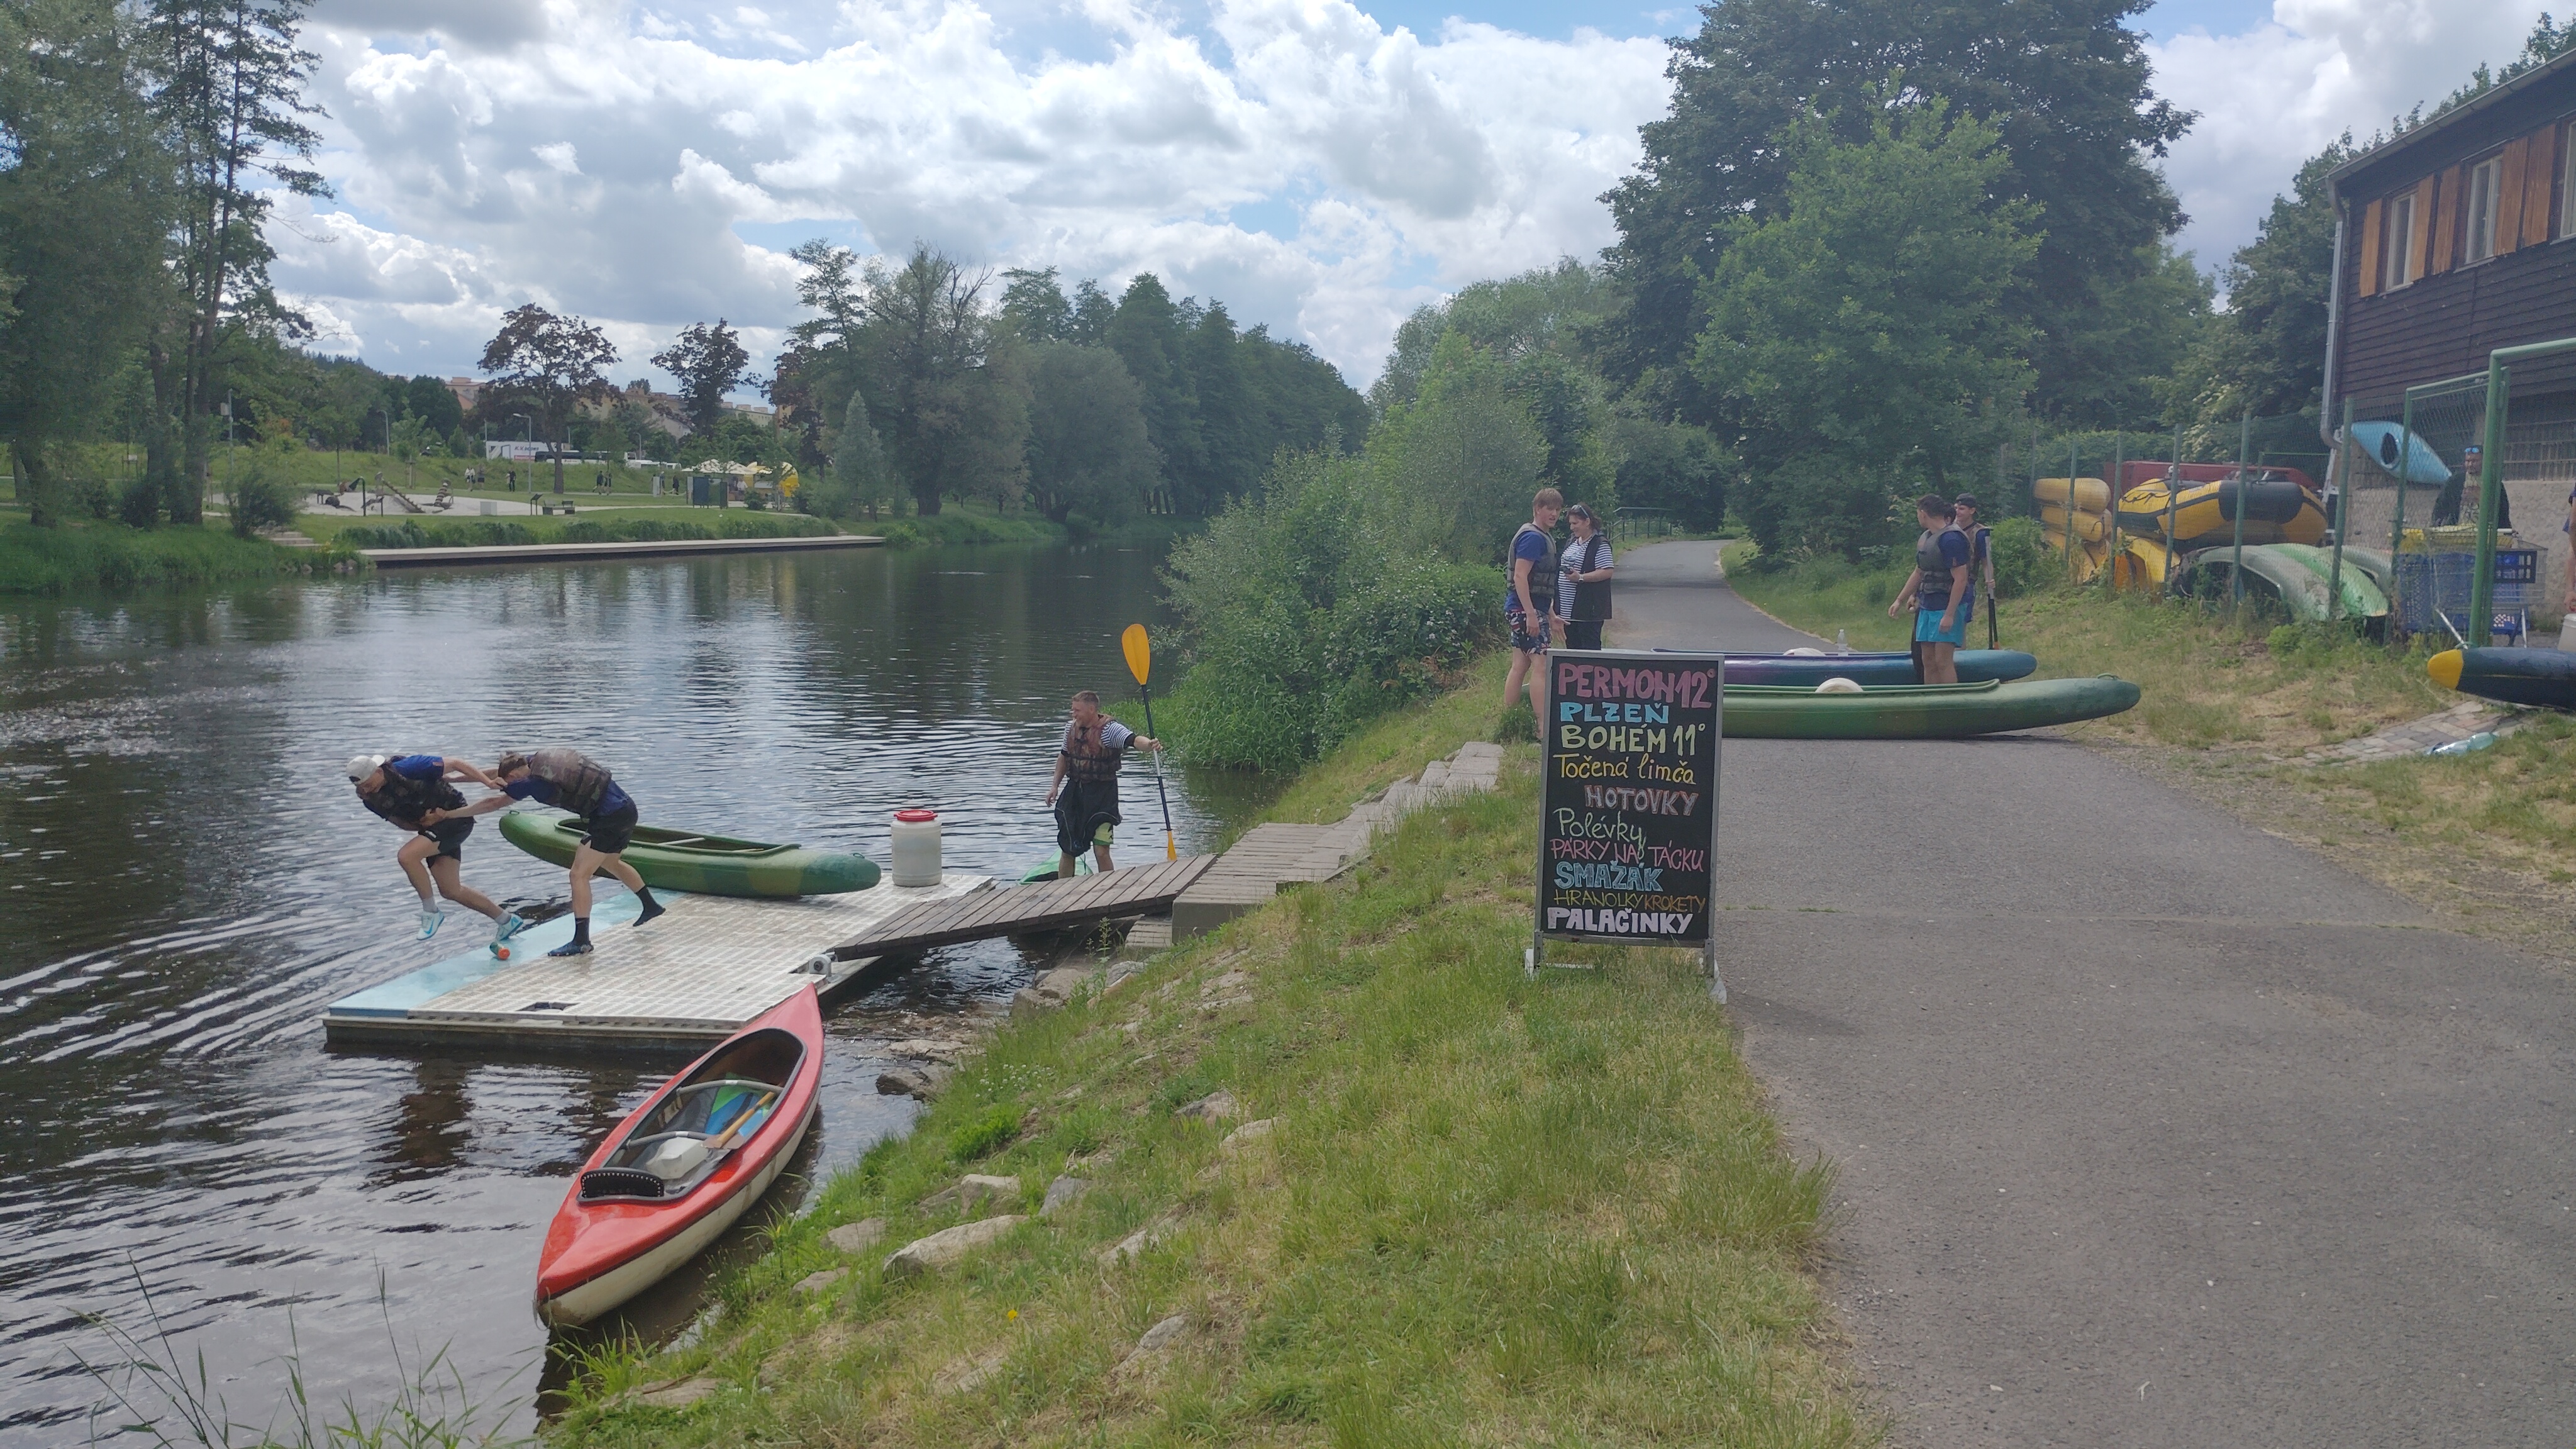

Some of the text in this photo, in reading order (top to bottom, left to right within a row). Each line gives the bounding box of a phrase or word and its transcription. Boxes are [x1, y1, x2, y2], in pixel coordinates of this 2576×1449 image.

[1558, 662, 1675, 703] PERMON
[1559, 702, 1669, 724] PLZEŇ
[1560, 723, 1706, 756] BOHÉM 11°
[1553, 753, 1697, 786] Točená limča
[1584, 785, 1699, 817] HOTOVKY
[1553, 808, 1646, 860] Polévky
[1550, 836, 1704, 872] PÁRKY NA TÁCKU
[1553, 859, 1663, 892] SMAŽÁK
[1553, 889, 1706, 913] HRANOLKY KROKETY
[1546, 907, 1694, 935] PALAČINKY
